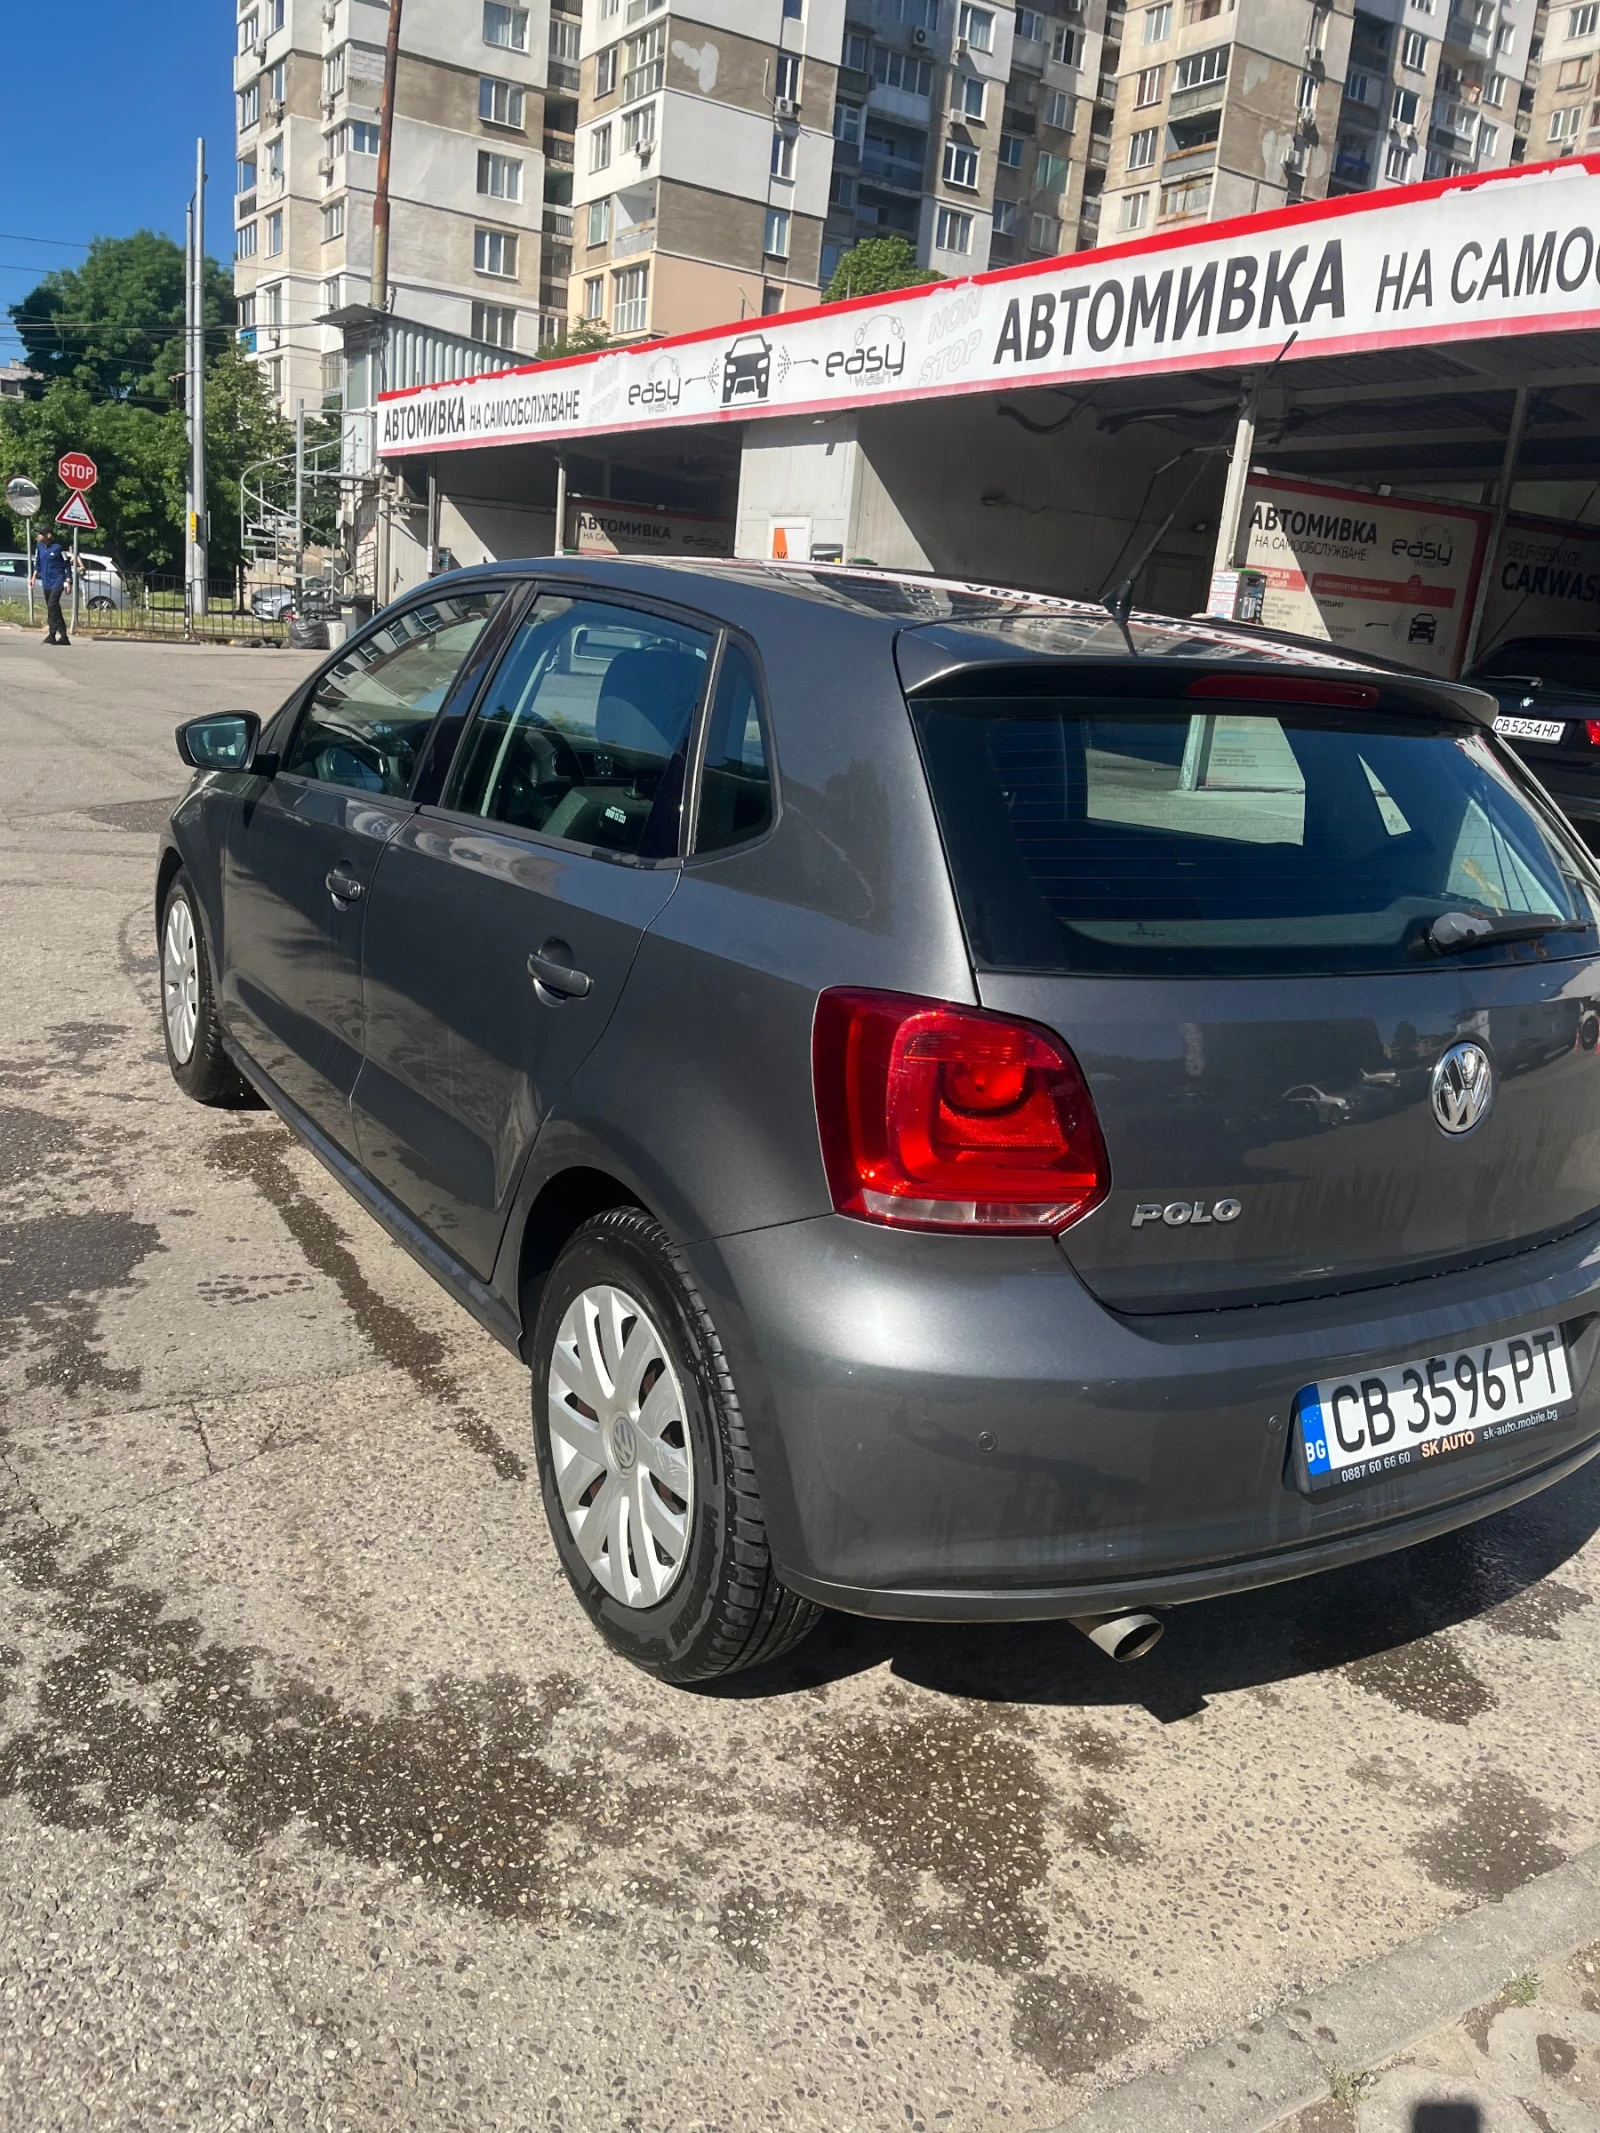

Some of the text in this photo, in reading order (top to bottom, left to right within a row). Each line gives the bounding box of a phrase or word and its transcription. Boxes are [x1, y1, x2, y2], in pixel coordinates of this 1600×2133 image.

[993, 225, 1600, 366] АВТОМИВКА НА САМО
[926, 288, 984, 346] NON
[825, 340, 906, 378] easy
[919, 329, 983, 387] STOP
[628, 377, 682, 406] easy
[854, 369, 892, 388] wash
[383, 389, 581, 443] АВТОМИВКА НА САМООБСЛУЖВАНЕ
[61, 462, 94, 480] STOP
[577, 516, 672, 540] АВТОМИВКА
[1249, 505, 1378, 545] АВТОМИВКА
[1255, 534, 1368, 562] НА САМООБСЛУЖВАНЕ
[1391, 538, 1453, 567] easy
[1501, 561, 1600, 603] CARWAS
[1494, 718, 1561, 738] CB 5254 HP
[1130, 1198, 1242, 1227] POLO
[1331, 1331, 1556, 1453] CB 3596 PT
[1482, 1408, 1559, 1441] sk-auto.mobile.bg
[1306, 1439, 1327, 1463] BG
[1421, 1430, 1475, 1459] SK AUTO
[1341, 1451, 1411, 1483] 0887 60 66 60
